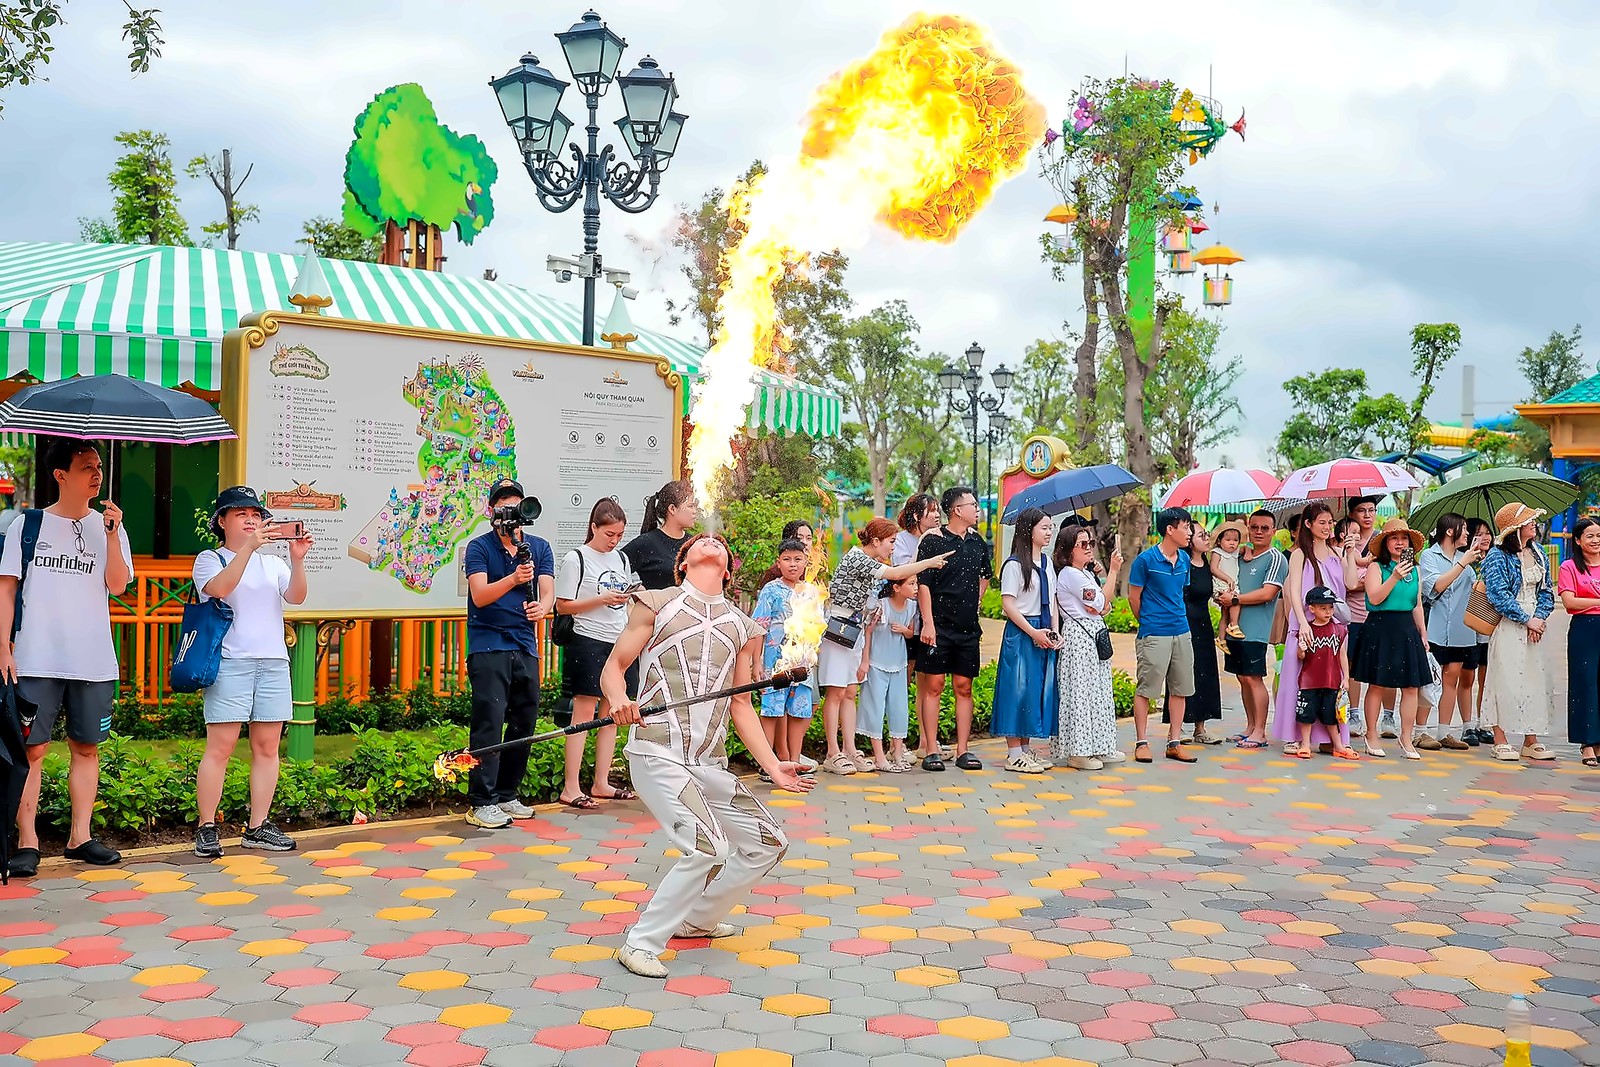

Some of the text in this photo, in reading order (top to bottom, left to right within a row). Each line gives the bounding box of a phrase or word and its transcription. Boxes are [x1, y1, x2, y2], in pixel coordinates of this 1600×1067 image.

[584, 392, 596, 400] NỘI
[596, 393, 609, 401] QUY
[34, 554, 96, 574] confident
